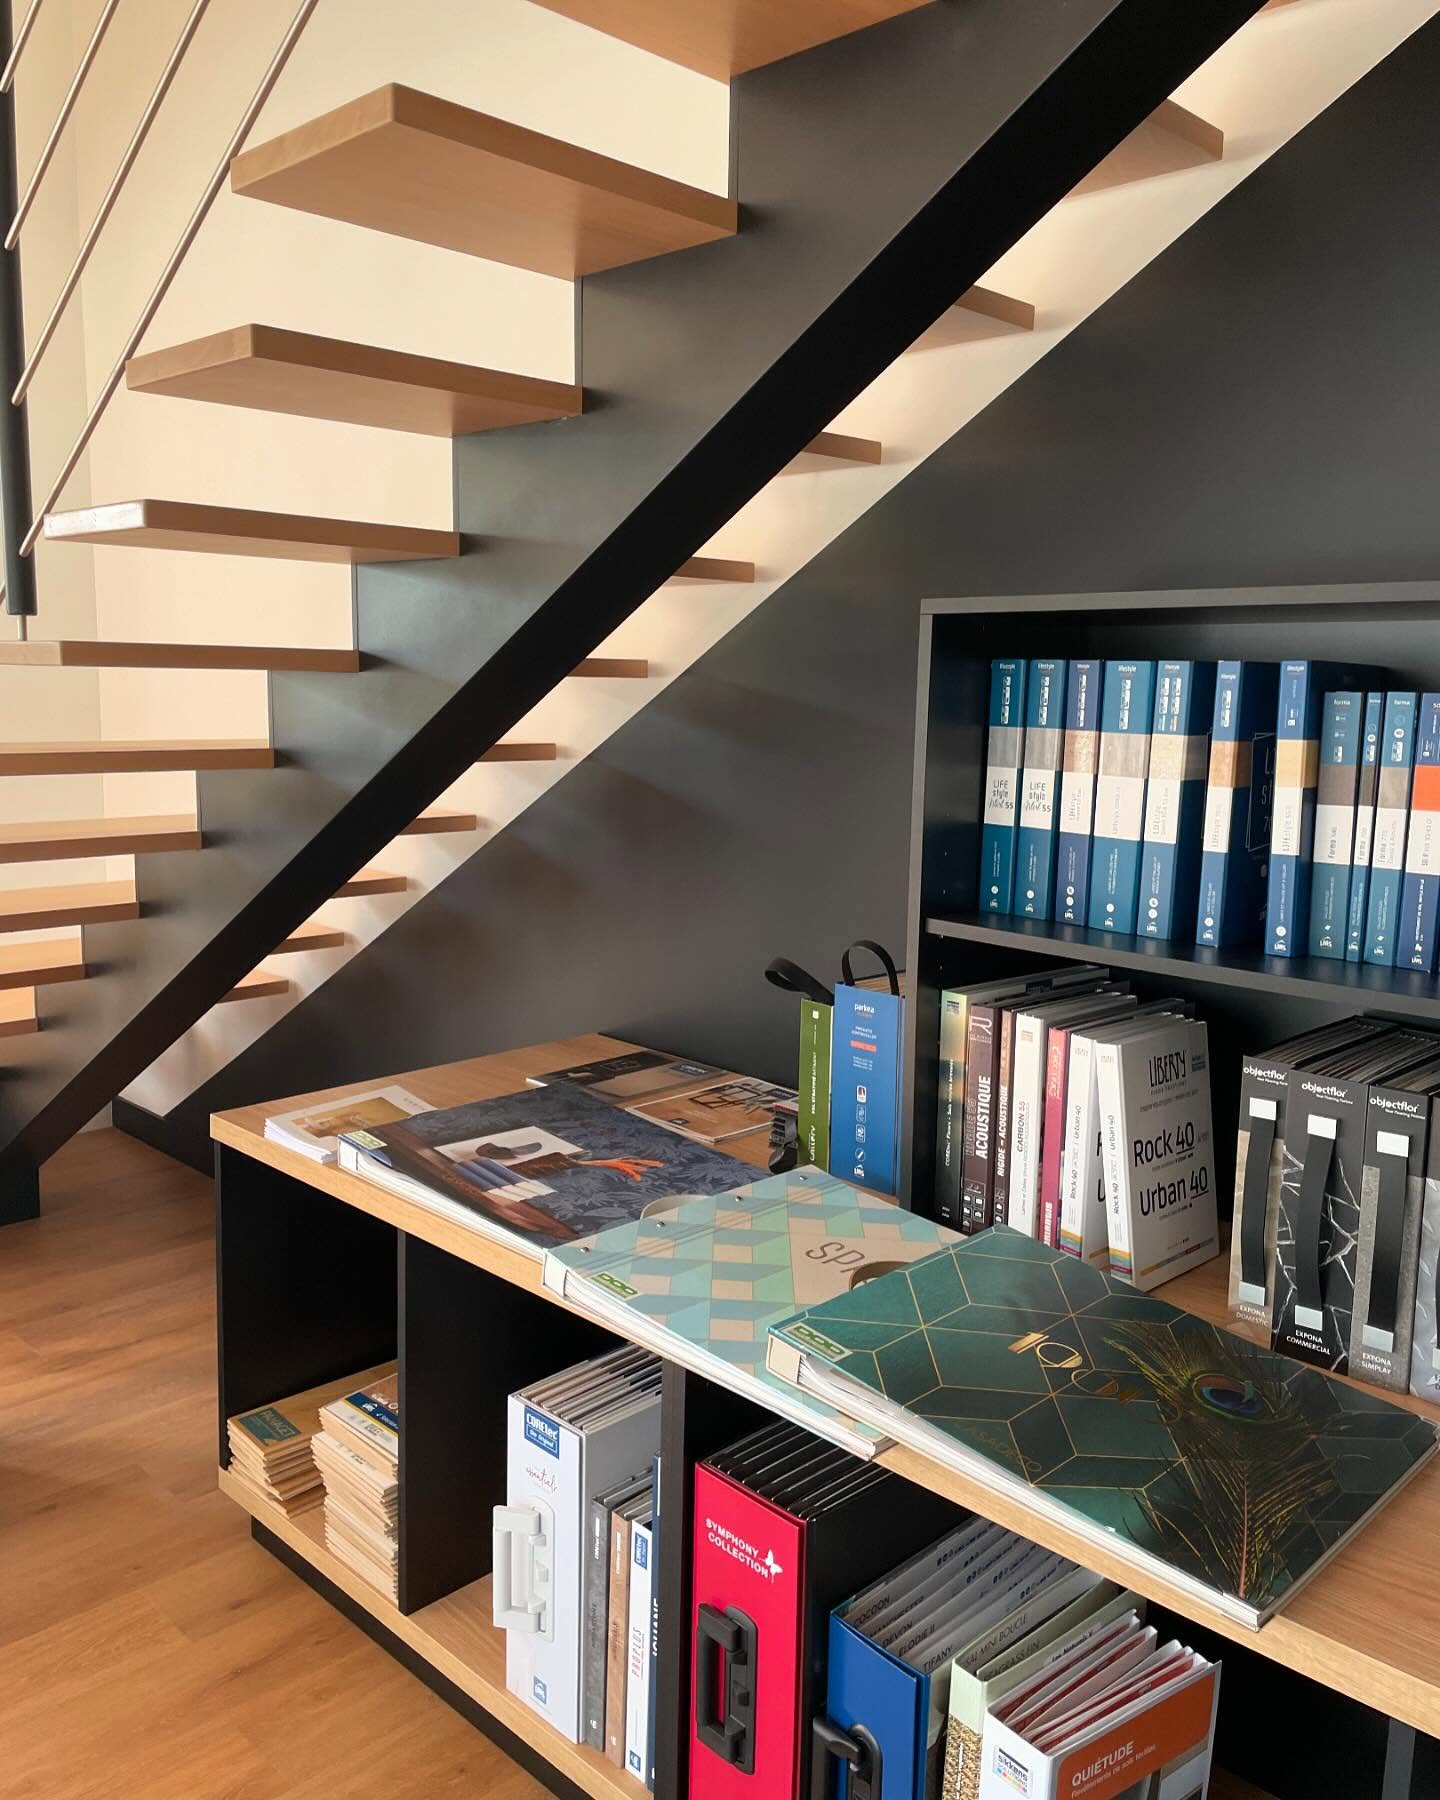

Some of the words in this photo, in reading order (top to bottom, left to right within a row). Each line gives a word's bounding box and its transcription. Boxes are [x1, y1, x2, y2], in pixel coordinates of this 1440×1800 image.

[854, 1003, 875, 1014] parkea
[1148, 1050, 1187, 1087] LIBERTY
[1243, 1065, 1286, 1080] objectflor
[1301, 1082, 1347, 1098] objectflor
[975, 1075, 992, 1160] ACOUSTIQUE
[999, 1085, 1008, 1140] ACOUSTIQUE
[1019, 1100, 1026, 1113] 55
[1369, 1096, 1418, 1113] objectflor
[1016, 1114, 1025, 1153] CARBON
[1133, 1128, 1173, 1168] Rock
[1175, 1121, 1195, 1151] 40
[997, 1147, 1005, 1177] RIGIDE
[1139, 1178, 1187, 1217] Urban
[1189, 1166, 1208, 1194] 40
[1235, 1312, 1269, 1327] DOMESTIC
[1239, 1304, 1266, 1318] EXPONA
[1286, 1335, 1331, 1356] COMMERCIAL
[1295, 1328, 1323, 1344] EXPONA
[1361, 1360, 1392, 1375] SIMPLAY
[1362, 1352, 1392, 1367] EXPONA
[705, 1517, 759, 1558] SYMPHONY
[708, 1532, 769, 1579] COLLECTION
[880, 1621, 913, 1649] DEVON
[631, 1626, 642, 1678] PROPLUS
[922, 1646, 952, 1673] TIFANY
[998, 1754, 1028, 1782] sikkens
